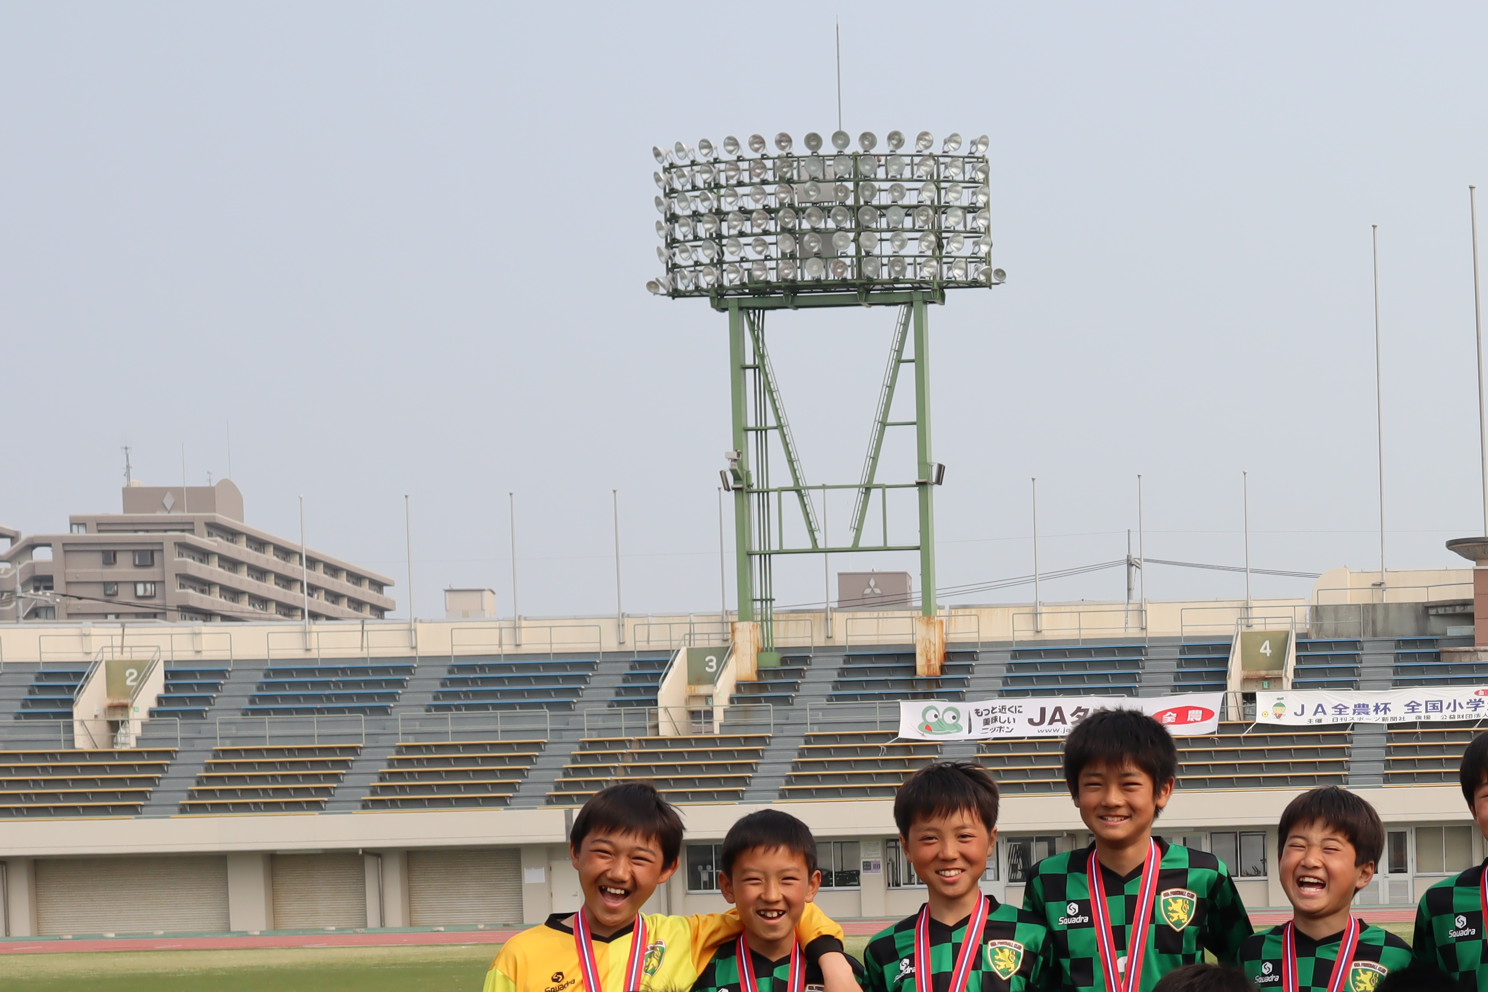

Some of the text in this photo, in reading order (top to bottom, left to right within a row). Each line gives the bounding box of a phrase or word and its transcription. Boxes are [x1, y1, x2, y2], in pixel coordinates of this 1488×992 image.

[1259, 640, 1272, 657] 4
[705, 655, 717, 672] 3
[125, 668, 138, 686] 2
[974, 705, 1023, 717] もっと近くに
[1293, 702, 1392, 717] JA全農杯
[982, 715, 1016, 727] 美味しい
[980, 725, 1015, 735] ニッポン
[1058, 915, 1089, 926] Squadra
[1449, 928, 1476, 939] Squadra
[1254, 974, 1280, 984] Squadra
